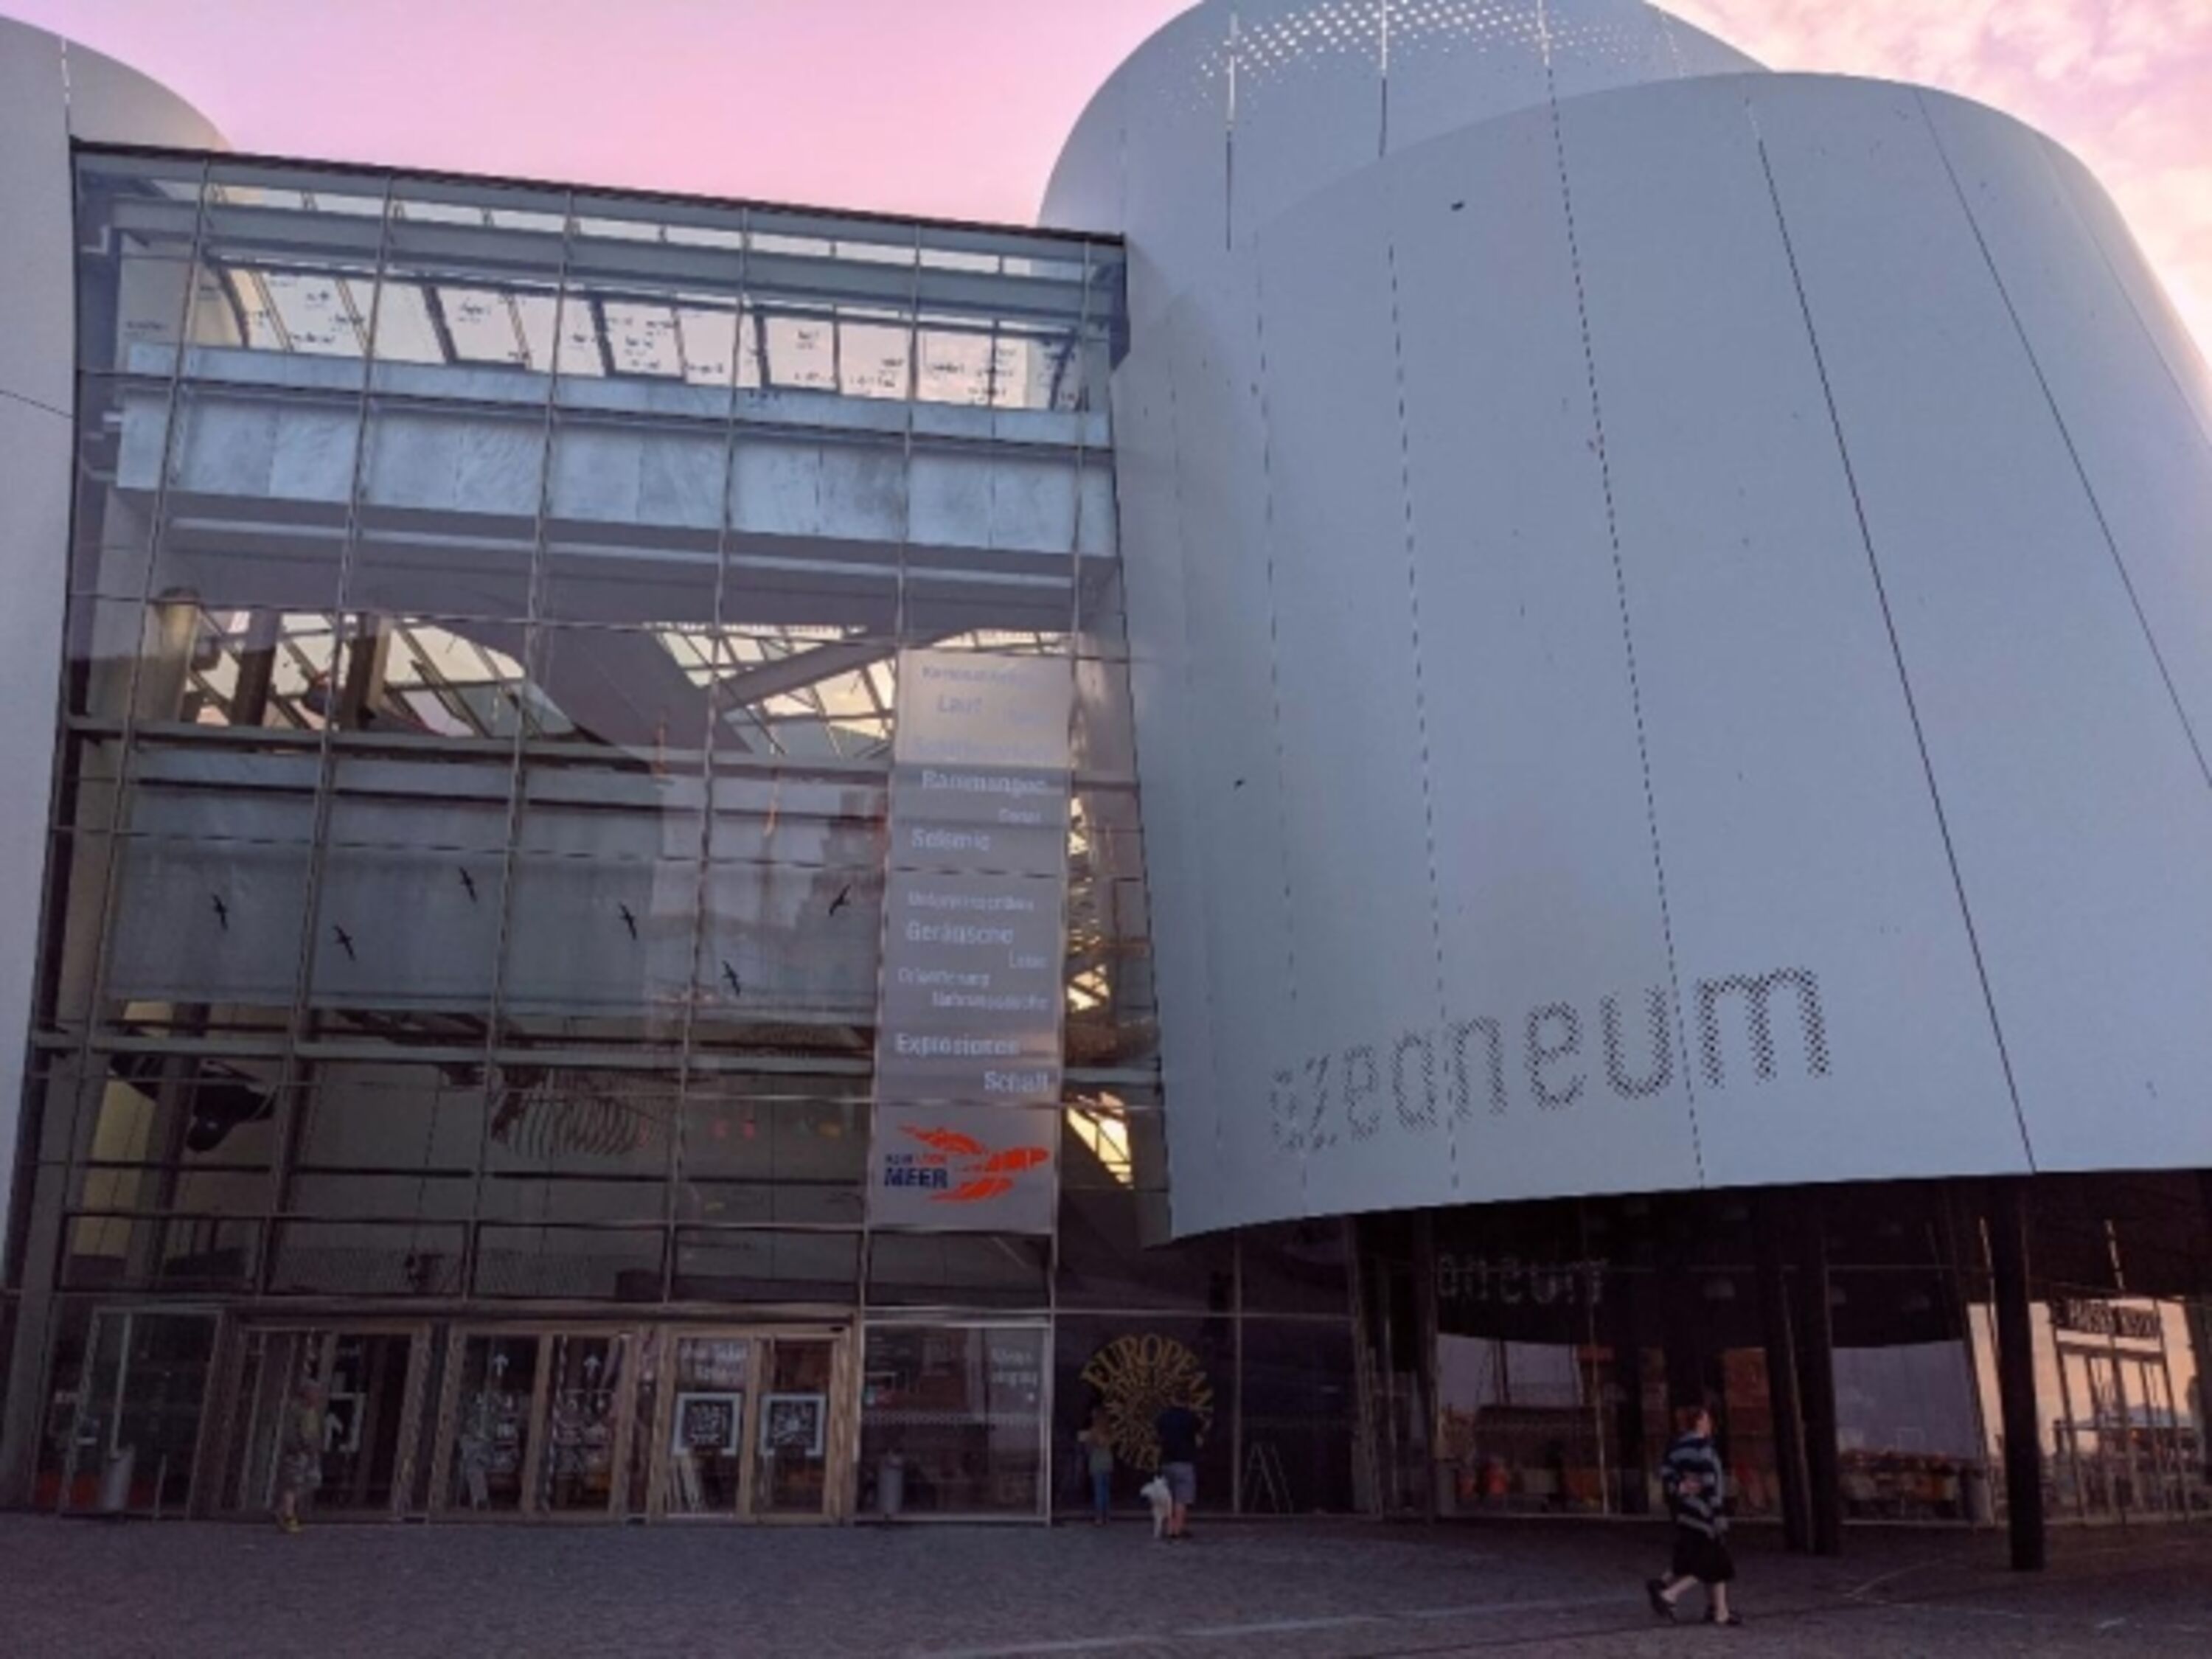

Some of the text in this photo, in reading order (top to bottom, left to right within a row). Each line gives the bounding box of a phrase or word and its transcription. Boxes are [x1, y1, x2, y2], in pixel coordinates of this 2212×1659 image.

[1267, 964, 1832, 1152] ozeaneum
[983, 1070, 1049, 1093] Schall
[884, 1167, 948, 1189] MEER
